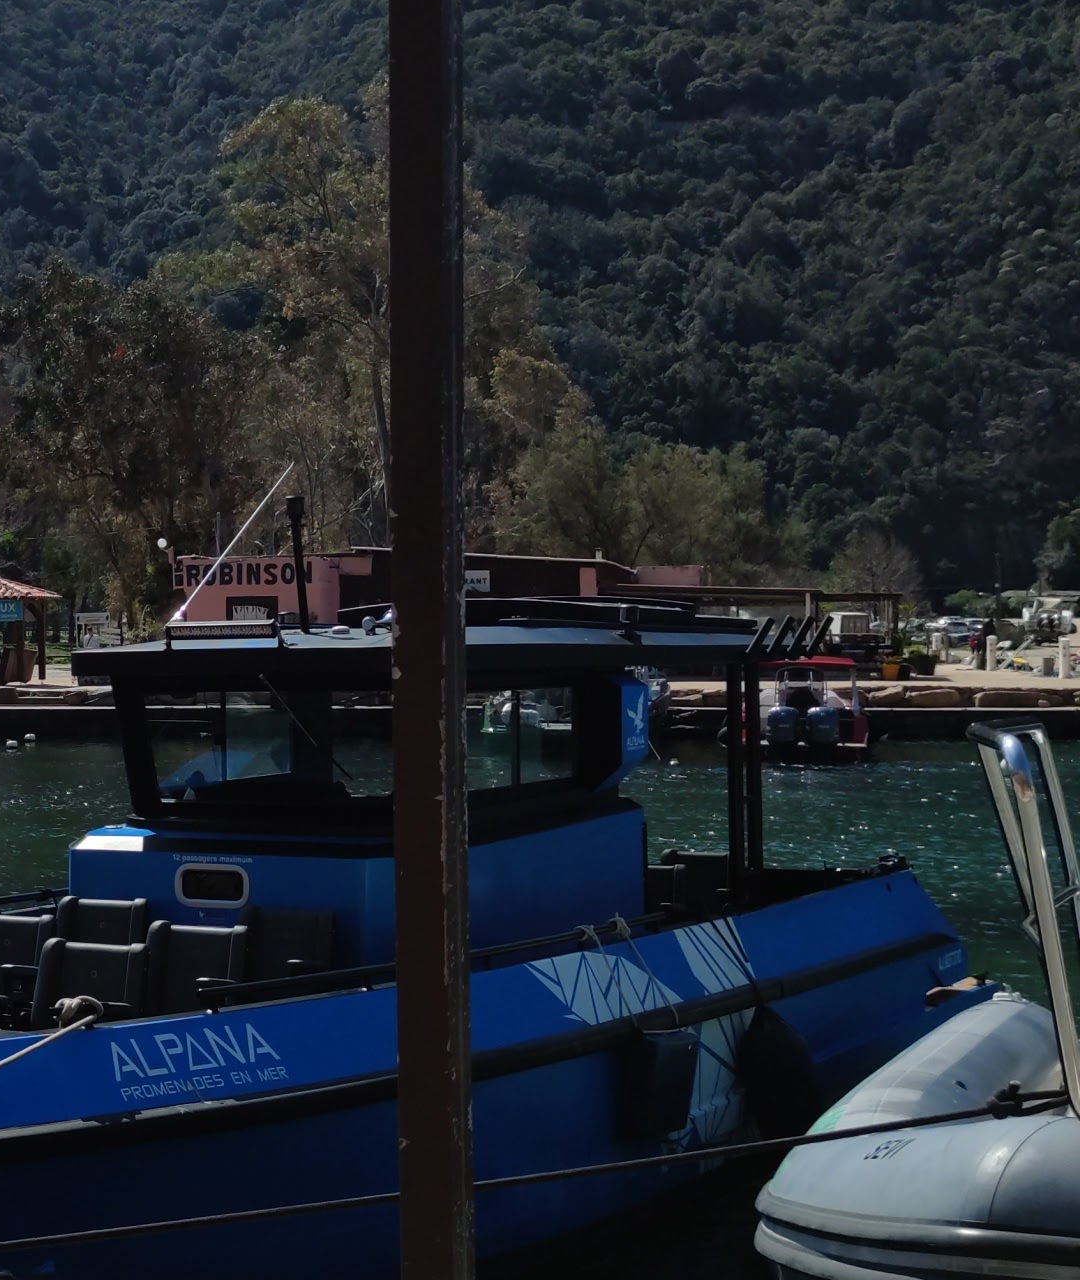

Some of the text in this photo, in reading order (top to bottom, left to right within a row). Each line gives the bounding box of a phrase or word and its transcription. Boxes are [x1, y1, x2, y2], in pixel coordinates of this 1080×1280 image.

[186, 561, 313, 587] ROBINSON
[110, 1023, 281, 1082] ALPANA
[120, 1066, 289, 1102] PROMENADES EN MER
